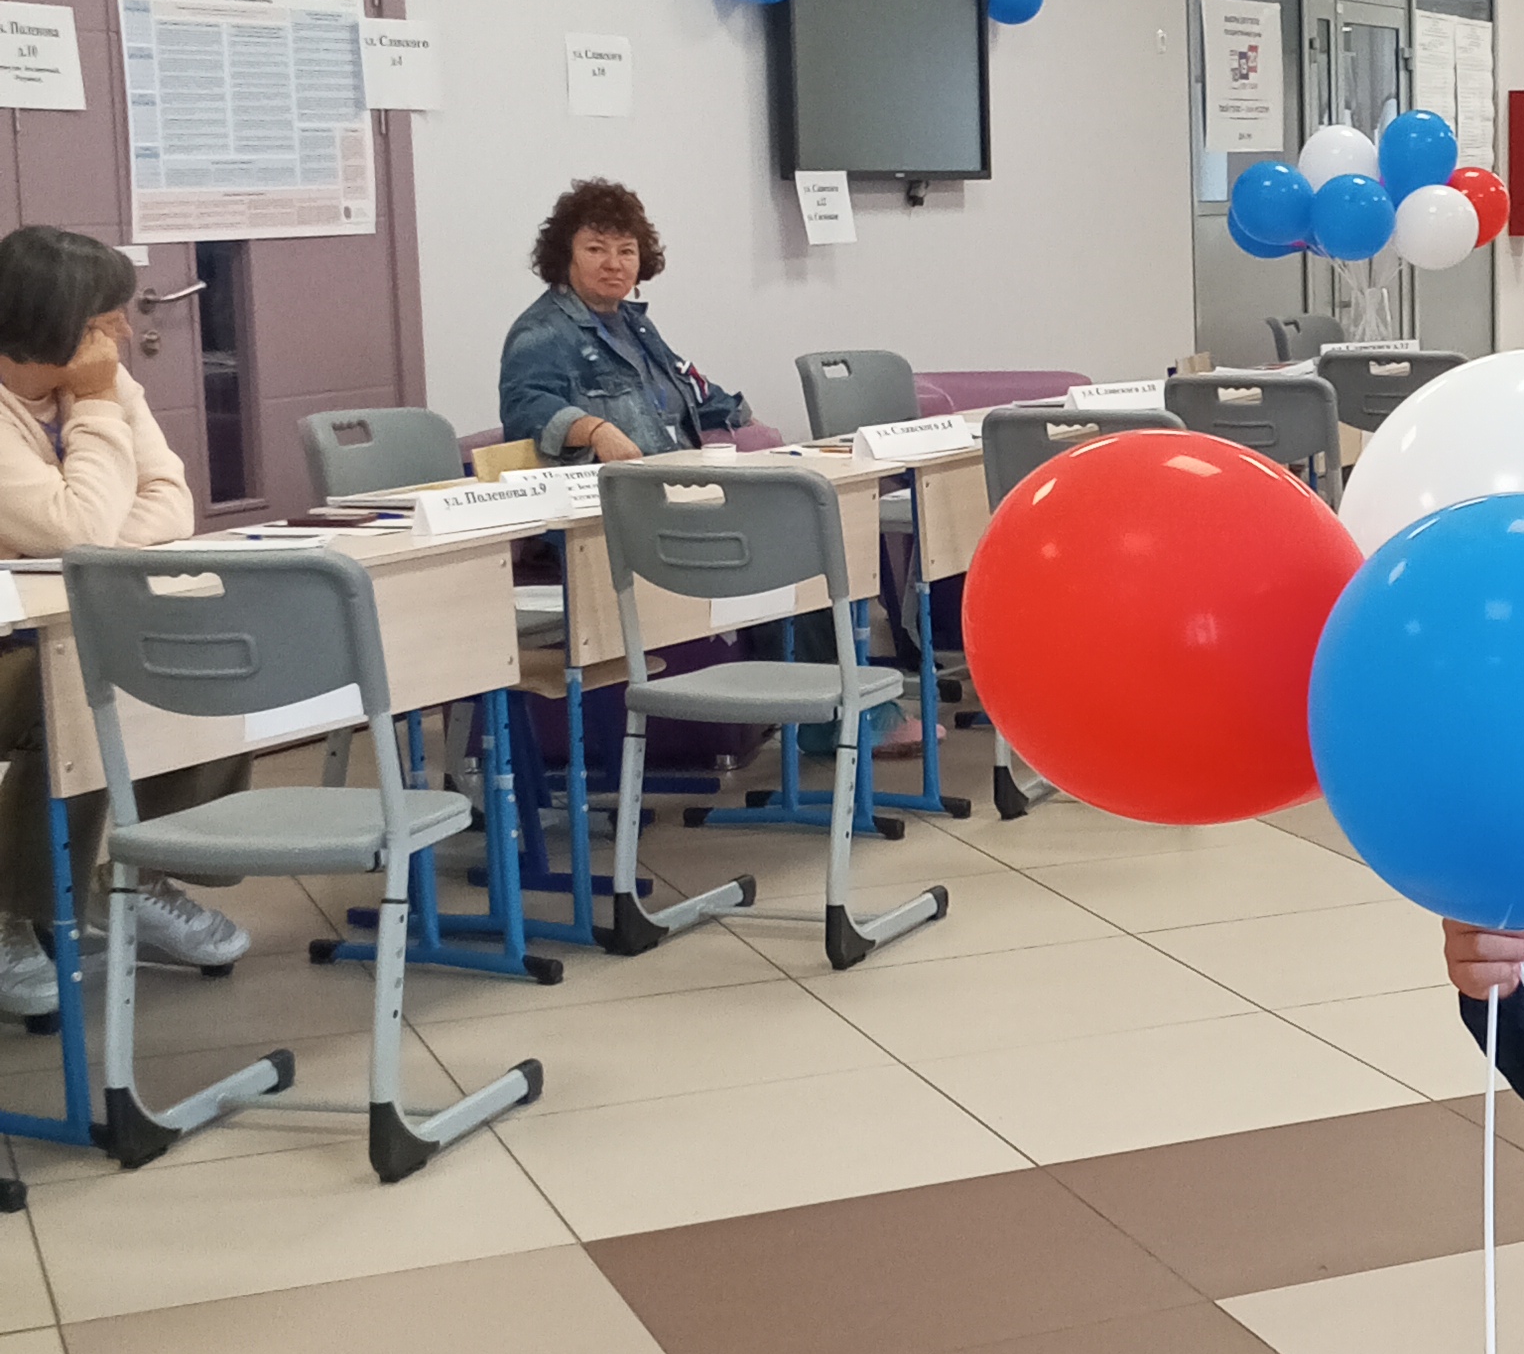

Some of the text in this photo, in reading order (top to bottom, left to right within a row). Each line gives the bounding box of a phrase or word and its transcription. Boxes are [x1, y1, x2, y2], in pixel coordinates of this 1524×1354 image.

[10, 21, 60, 38] Поленова
[443, 482, 547, 511] ул. Поленова д.9
